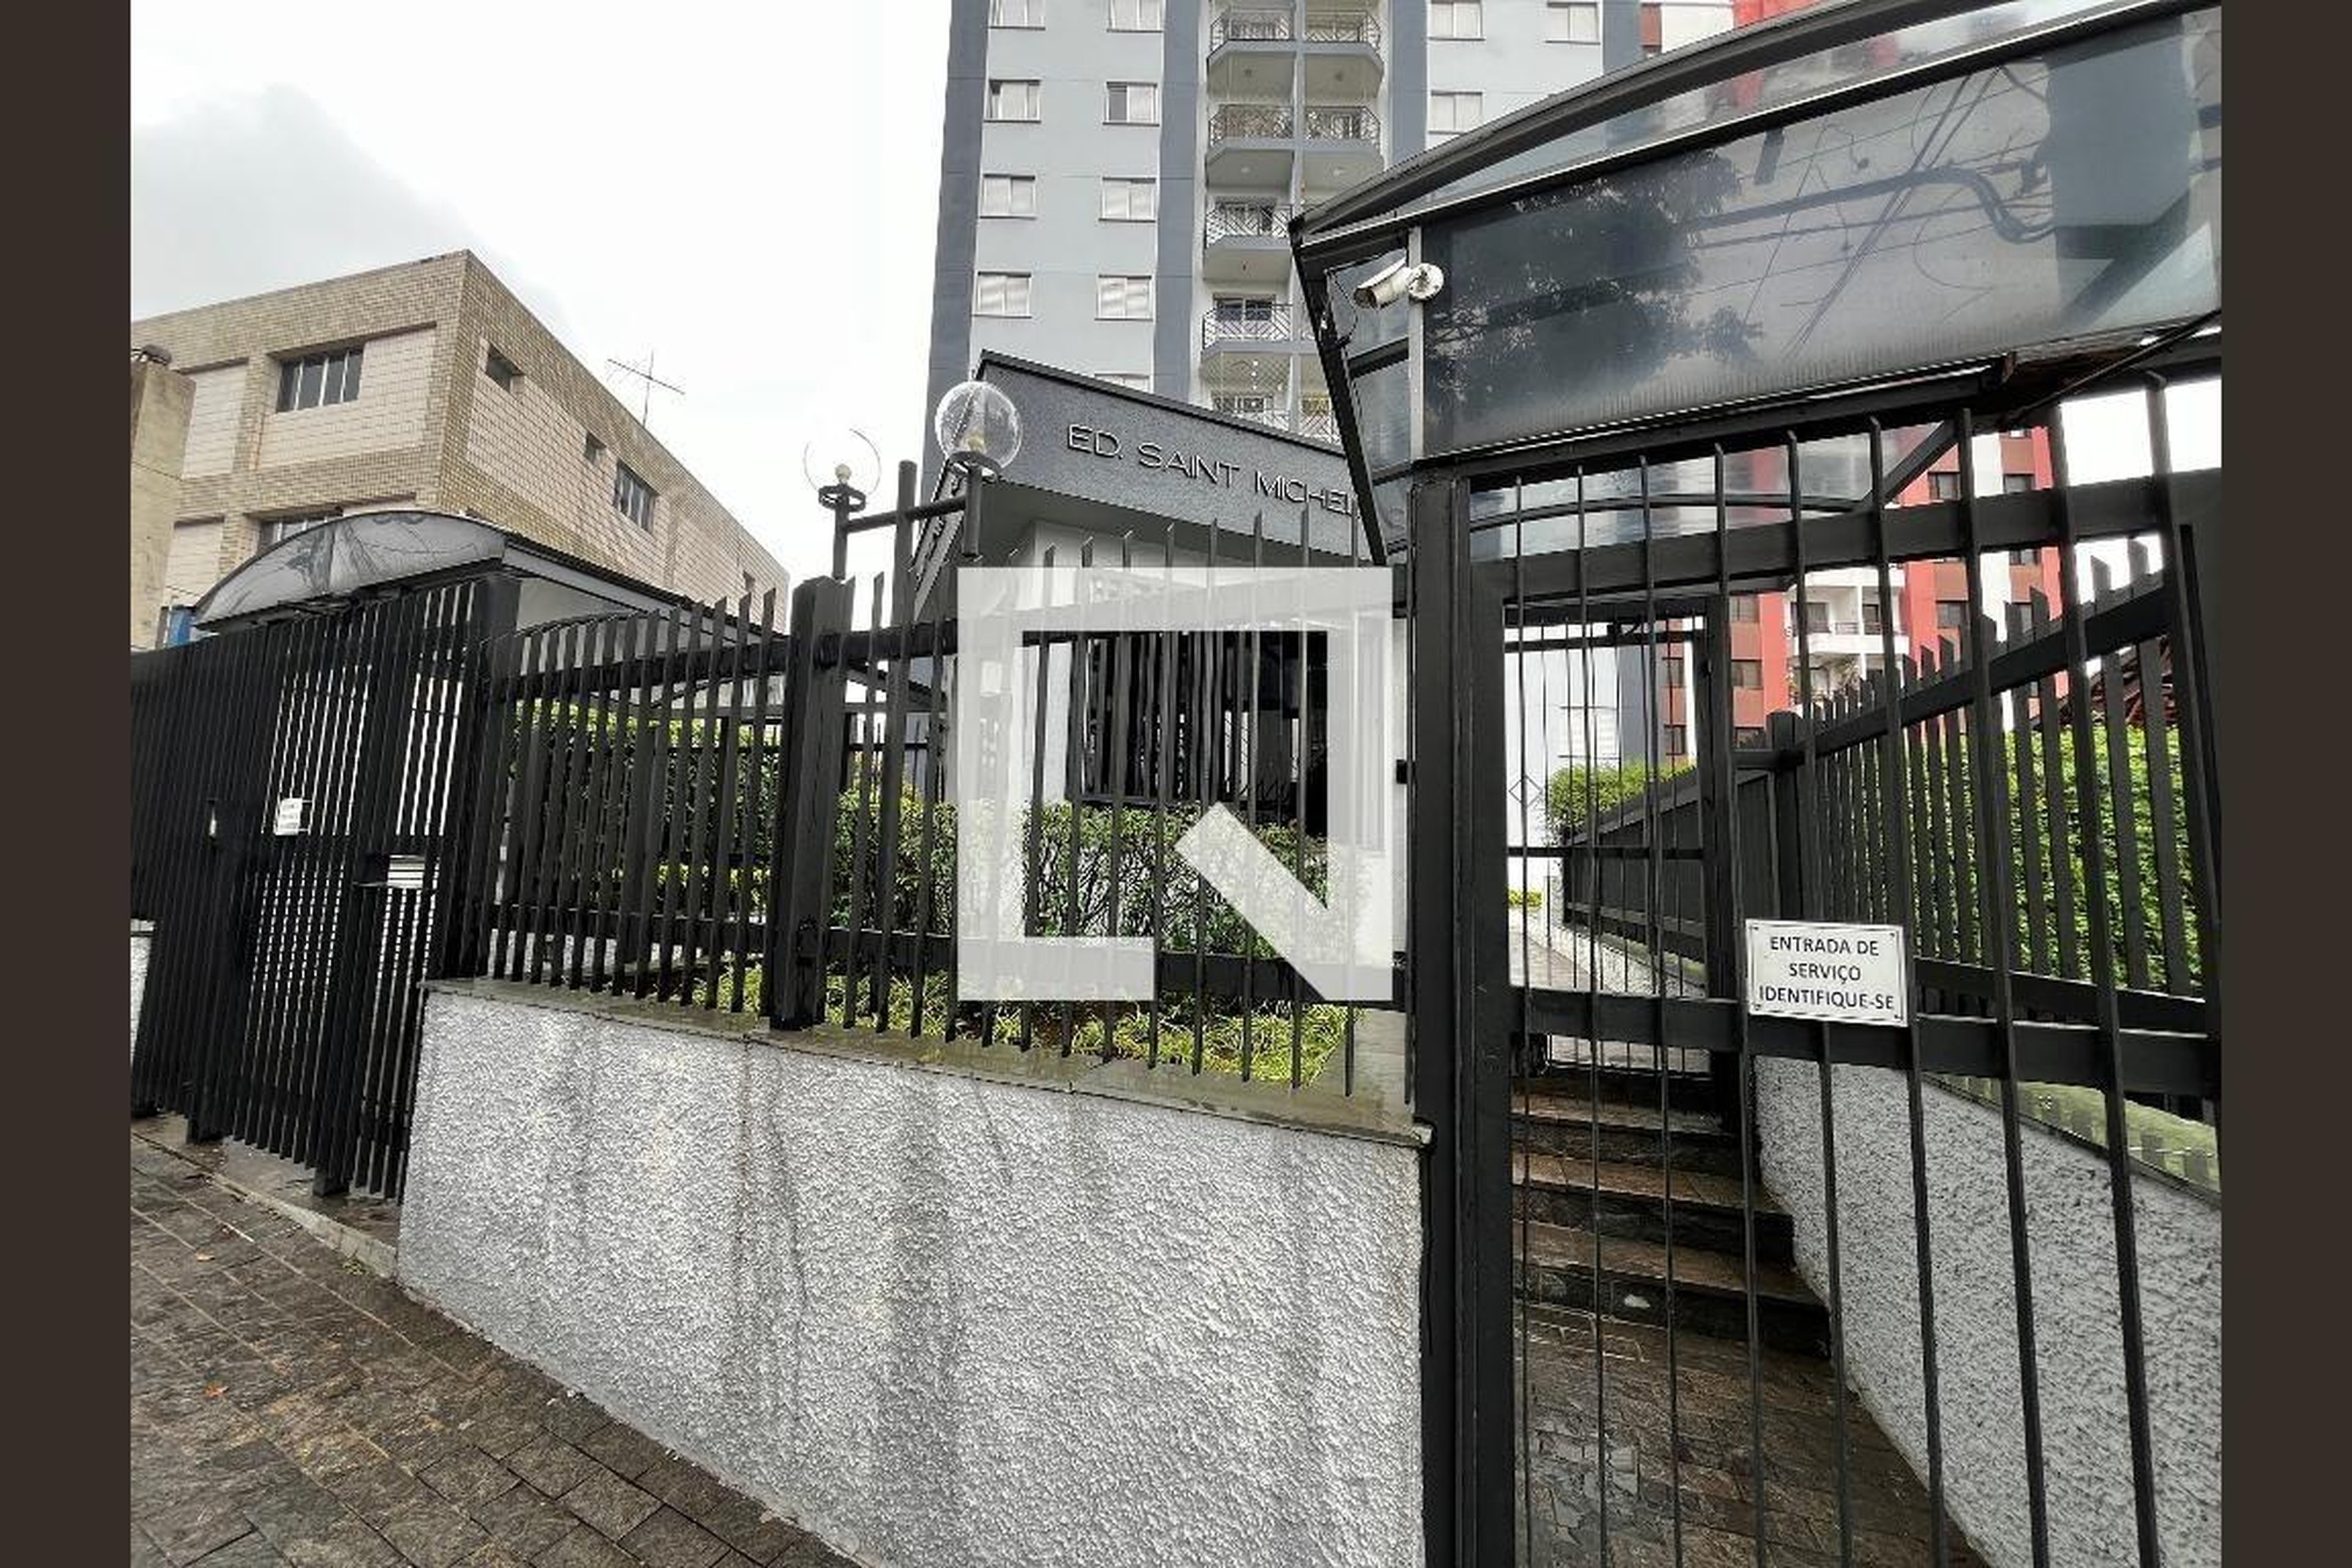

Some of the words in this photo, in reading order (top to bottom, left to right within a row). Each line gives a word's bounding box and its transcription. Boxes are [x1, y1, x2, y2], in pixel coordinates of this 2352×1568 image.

[1068, 424, 1123, 459] ED.
[1137, 442, 1240, 488] SAINT
[1770, 936, 1850, 954] ENTRADA
[1857, 941, 1879, 956] DE
[1789, 963, 1861, 984] SERVIÇO
[1759, 986, 1894, 1009] IDENTIFIQUE-SE
